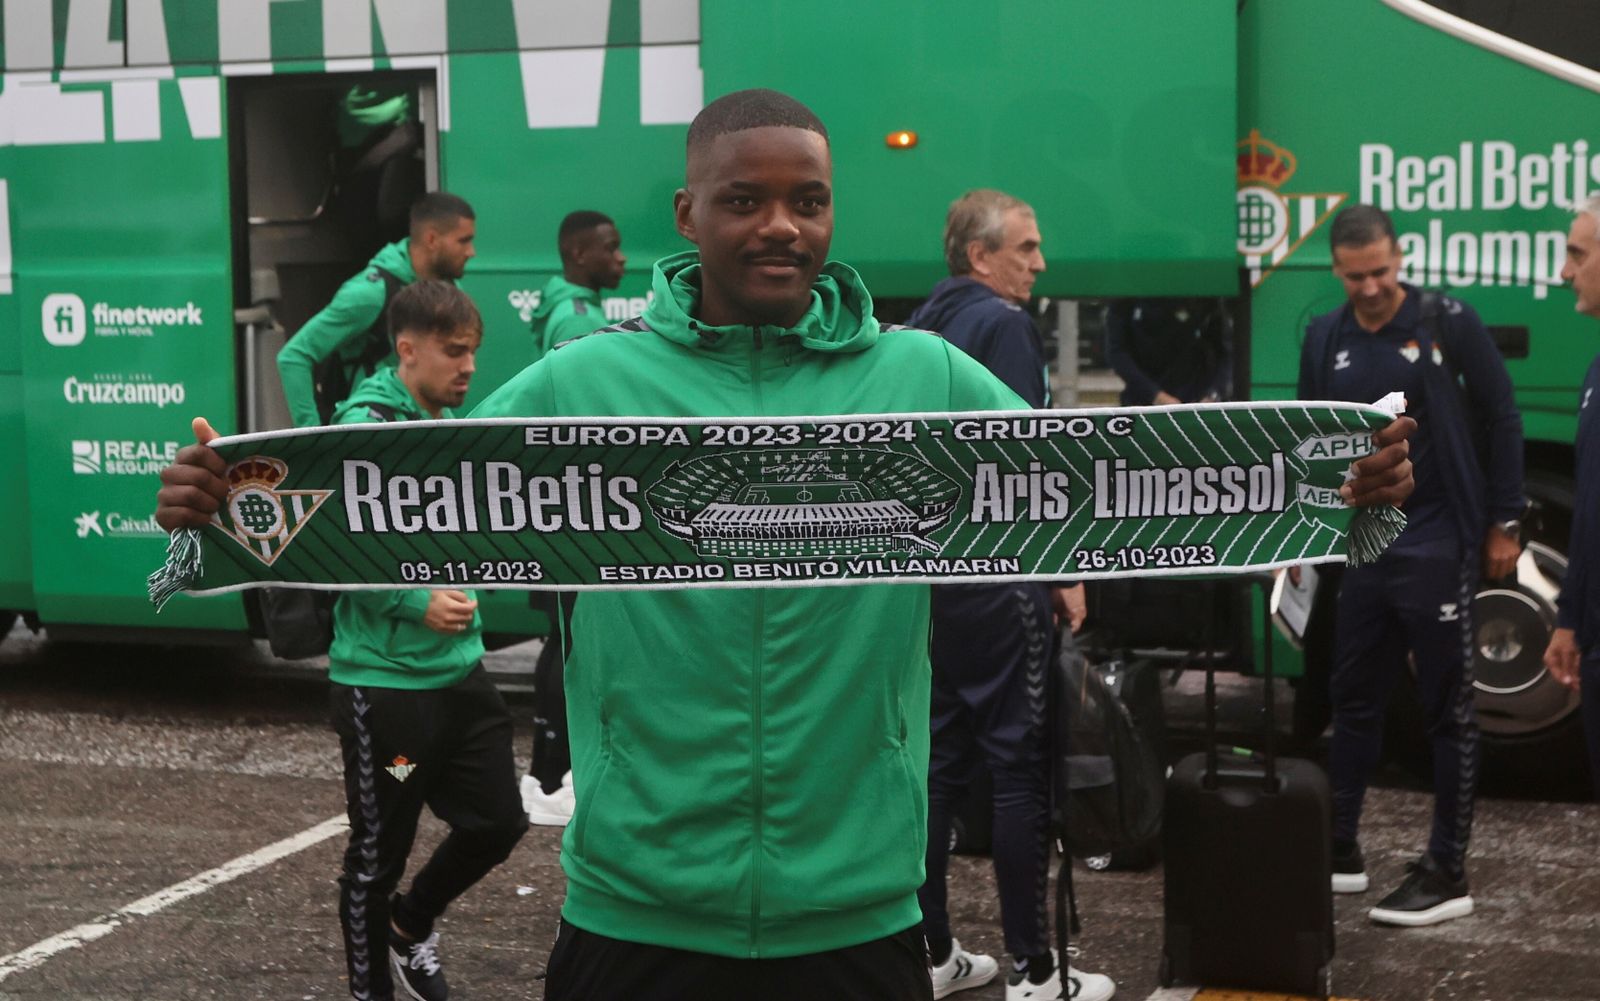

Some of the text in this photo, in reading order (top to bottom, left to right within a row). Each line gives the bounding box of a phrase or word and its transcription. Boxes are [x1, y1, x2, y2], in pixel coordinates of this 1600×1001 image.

[1360, 141, 1474, 211] Real
[92, 302, 203, 325] finetwork
[63, 376, 186, 408] Cruzcampo
[524, 426, 690, 446] EUROPA
[702, 421, 916, 446] 2023-2024
[954, 418, 1094, 440] GRUPO
[1107, 417, 1133, 435] C
[104, 441, 179, 461] REALE
[343, 460, 642, 533] Real Betis
[971, 452, 1286, 523] Aris Limassol
[400, 561, 543, 581] 09-11-2023
[599, 565, 724, 581] ESTADIO
[734, 560, 840, 578] BENITO
[1075, 546, 1216, 570] 26-10-2023
